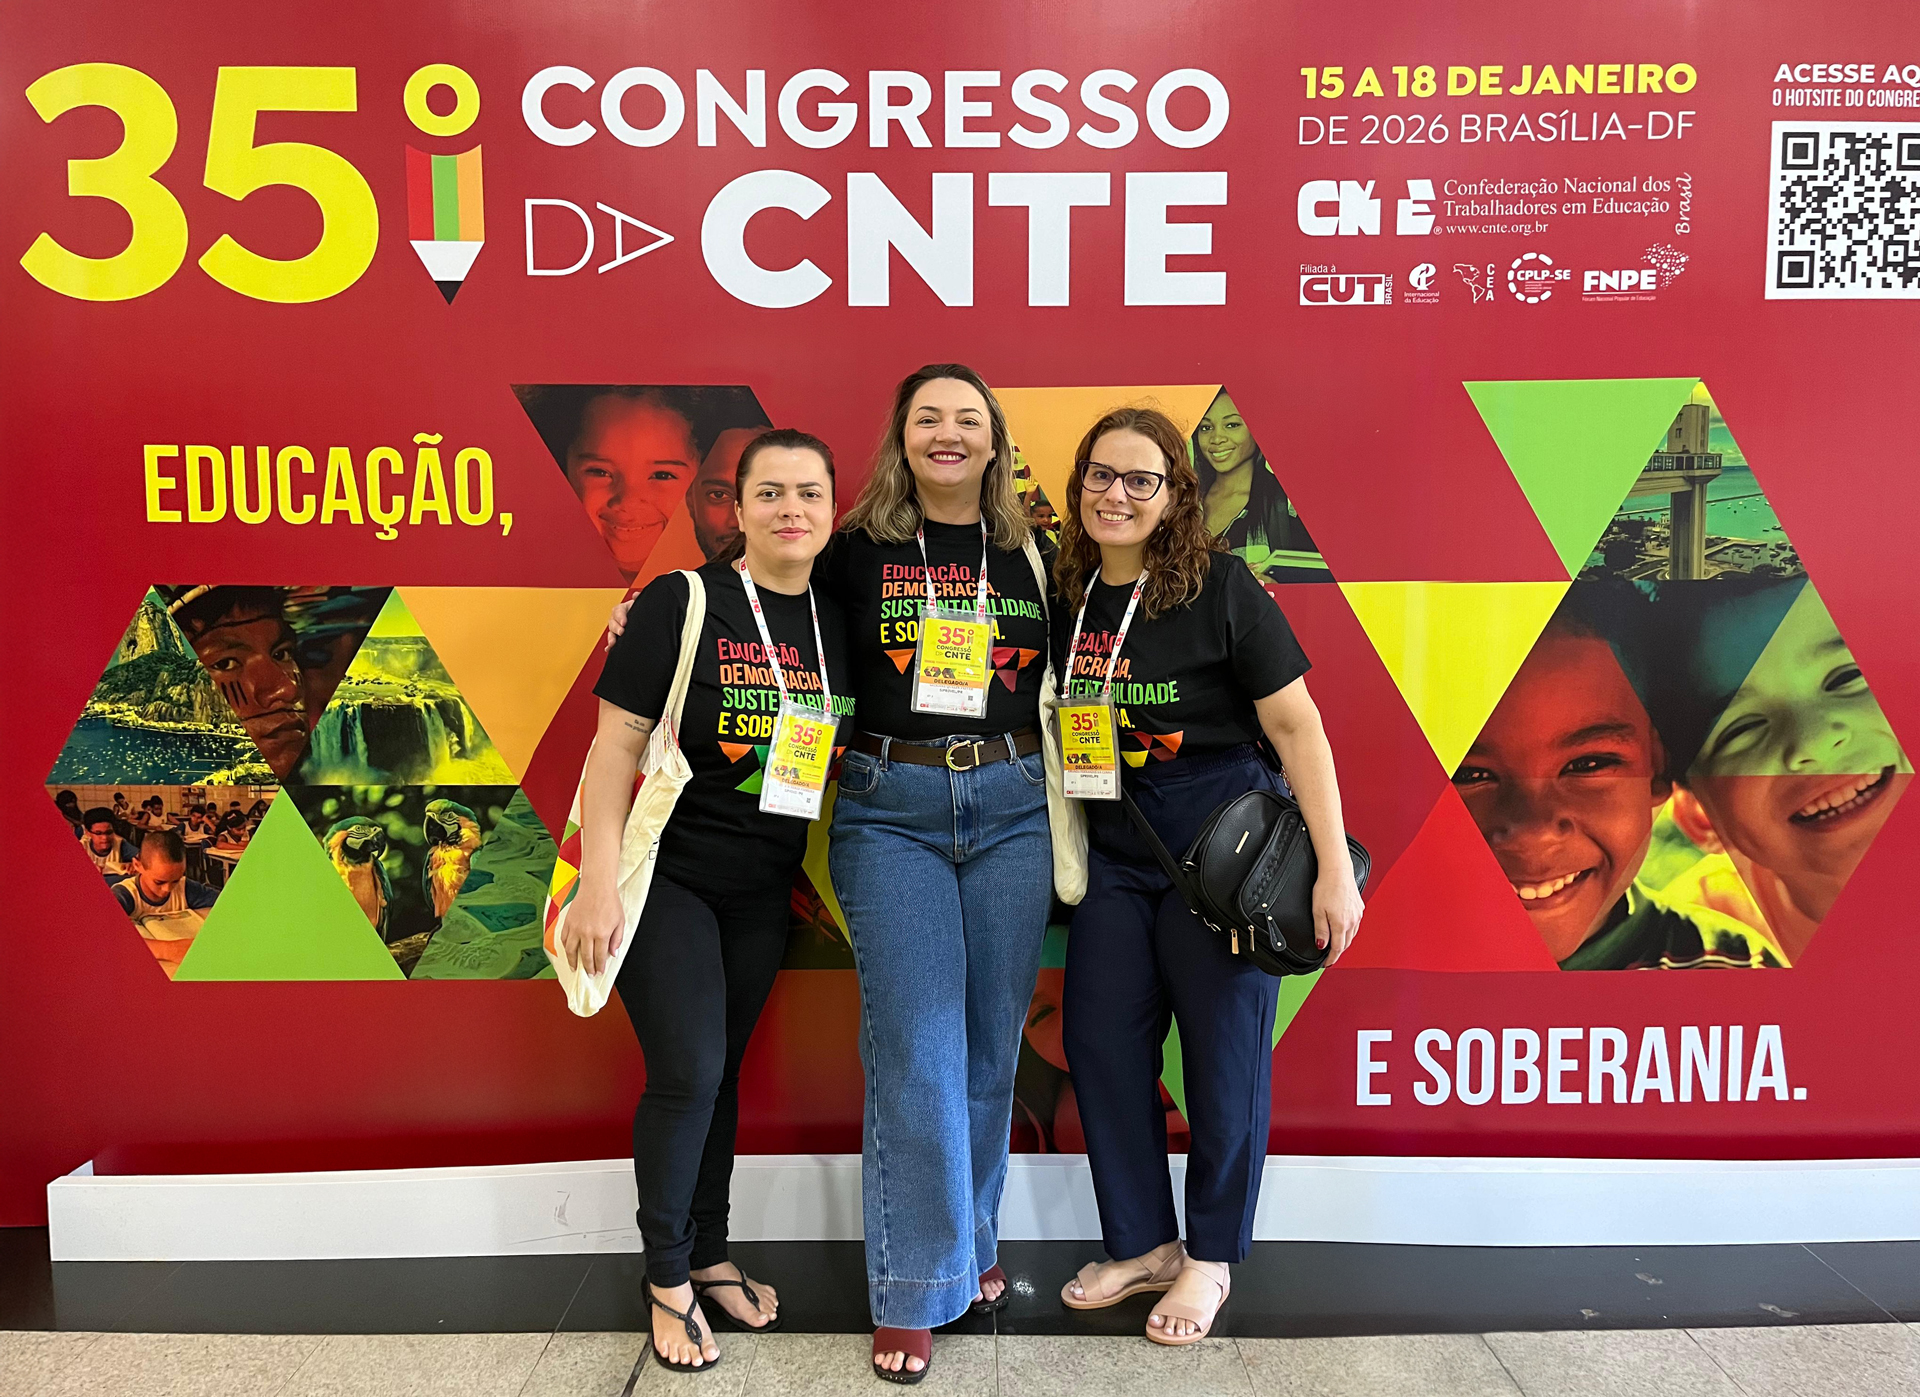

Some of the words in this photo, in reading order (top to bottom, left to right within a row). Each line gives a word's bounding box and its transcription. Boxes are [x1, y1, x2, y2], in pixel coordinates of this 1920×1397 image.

[1300, 66, 1345, 99] 15
[1352, 66, 1384, 98] A
[1392, 65, 1437, 98] 18
[1448, 65, 1503, 96] DE
[1509, 62, 1698, 96] JANEIRO
[1773, 63, 1876, 83] ACESSE
[522, 65, 1230, 150] CONGRESSO
[1772, 88, 1782, 107] O
[1785, 88, 1843, 107] HOTSITE
[1845, 89, 1864, 107] DO
[1867, 89, 1920, 108] CONGRE
[1299, 116, 1349, 145] DE
[1360, 114, 1450, 145] 2026
[1443, 177, 1559, 198] Confederação
[1563, 176, 1637, 194] Nacional
[1642, 176, 1671, 193] dos
[1443, 199, 1558, 217] Trabalhadores
[1562, 205, 1587, 215] em
[1592, 197, 1670, 217] Educação
[1674, 171, 1692, 236] Brasil
[524, 197, 676, 276] DA
[701, 169, 1228, 309] CNTE
[1446, 220, 1549, 237] www.cnte.org.br
[1300, 263, 1328, 274] Filiada
[1330, 263, 1337, 273] à
[1516, 269, 1571, 281] CPLP-SE
[1302, 276, 1384, 303] CUT
[1384, 273, 1393, 305] BRASIL
[1583, 269, 1657, 291] FNPE
[143, 432, 514, 541] EDUCAÇÃO,
[880, 622, 891, 644] E
[944, 651, 971, 661] CNTE
[718, 711, 731, 735] E
[1079, 736, 1101, 744] CNTE
[794, 750, 817, 761] CNTE
[1356, 1029, 1393, 1106] E
[1412, 1024, 1808, 1106] SOBERANIA.
